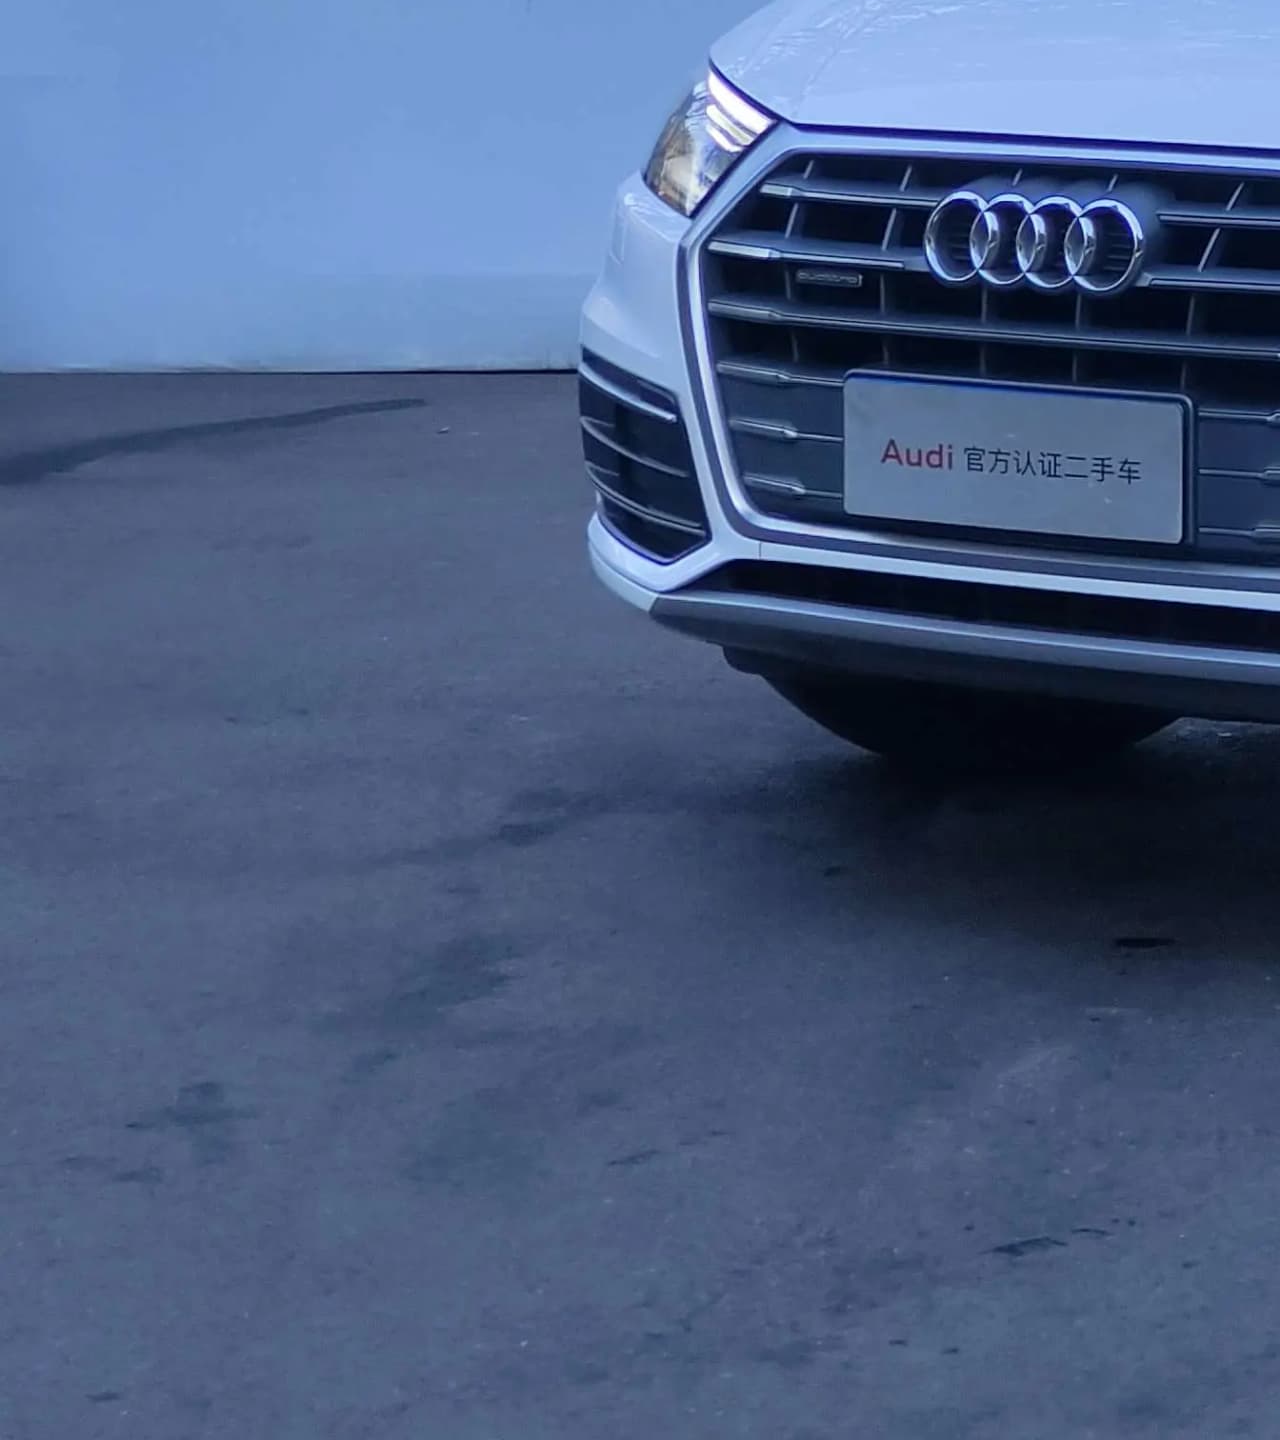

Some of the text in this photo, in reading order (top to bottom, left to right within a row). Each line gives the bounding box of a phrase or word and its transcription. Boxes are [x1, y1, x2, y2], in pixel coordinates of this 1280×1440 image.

[881, 438, 1142, 484] Audi 官方认证二手车
